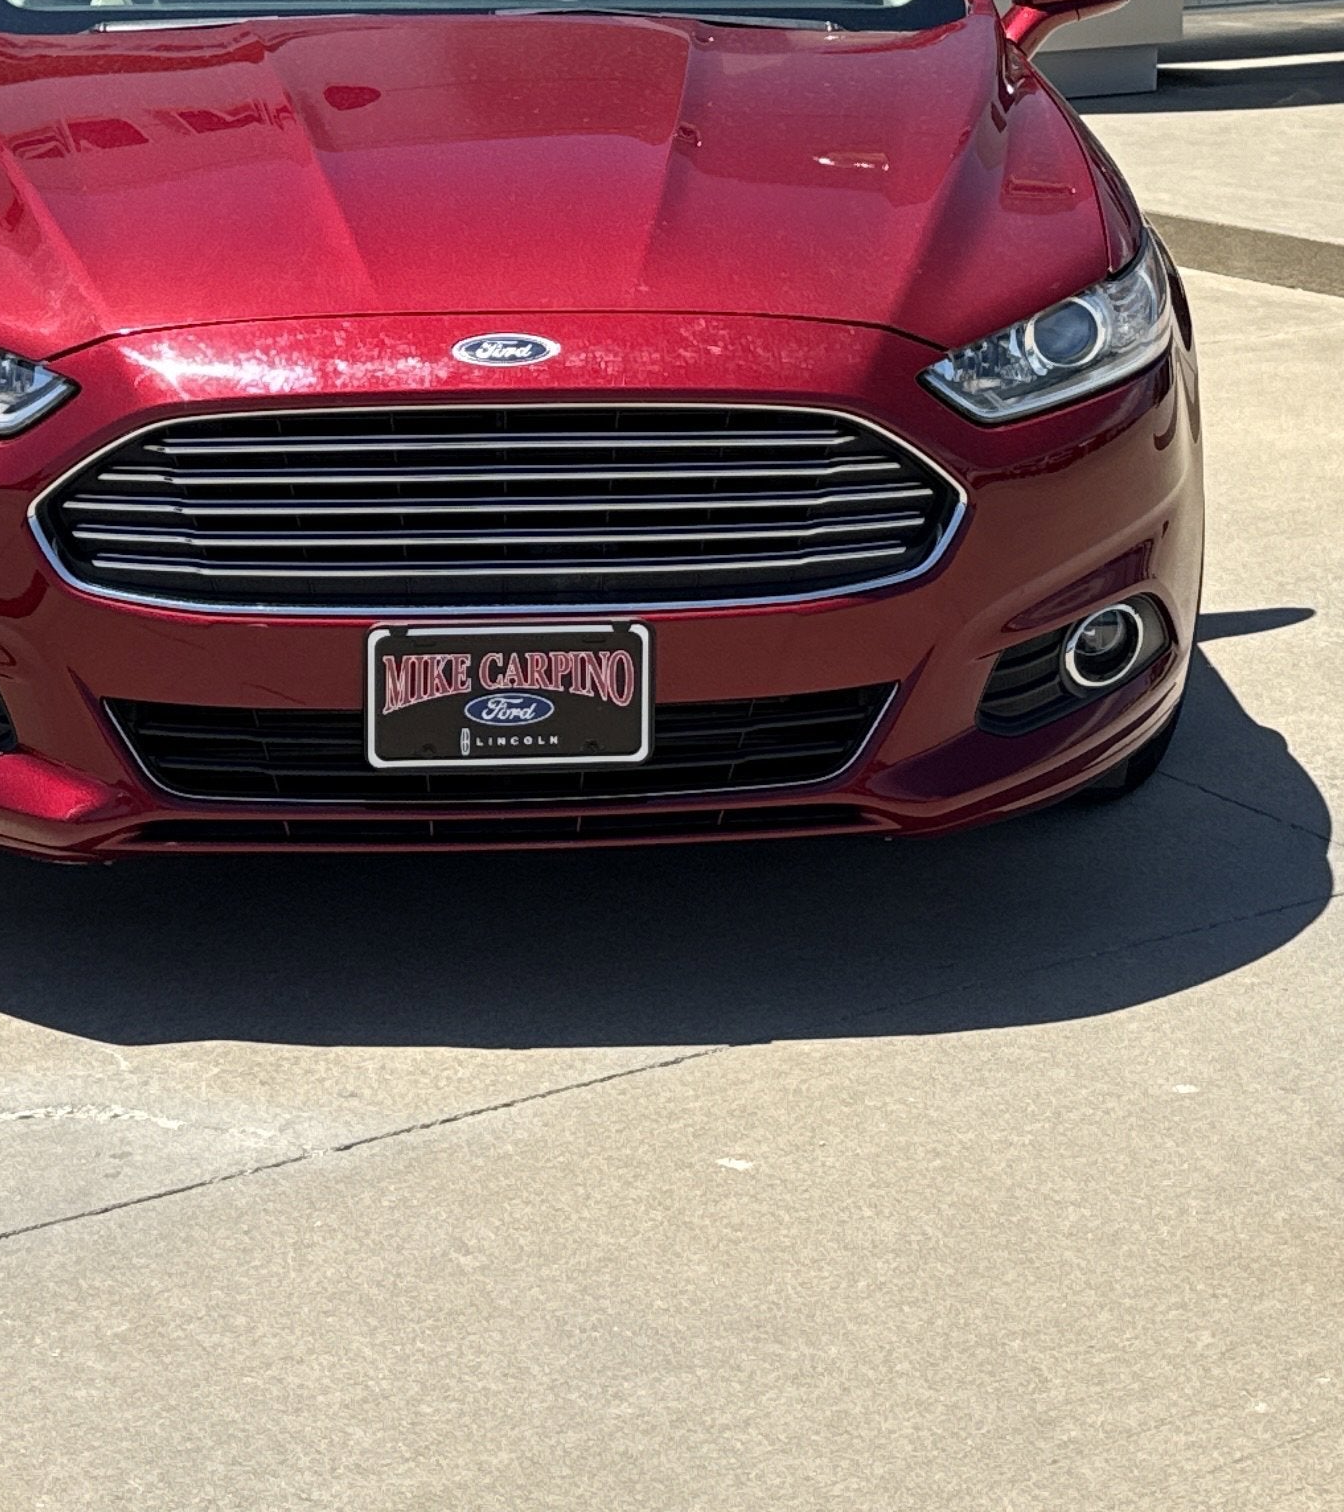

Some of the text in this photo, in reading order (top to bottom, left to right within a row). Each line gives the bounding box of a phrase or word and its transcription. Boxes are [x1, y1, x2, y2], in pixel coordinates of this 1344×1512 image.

[475, 340, 533, 359] Ford
[382, 650, 635, 715] MIKE CARPINO
[481, 696, 536, 721] Ford
[475, 735, 559, 747] LINCOLN
